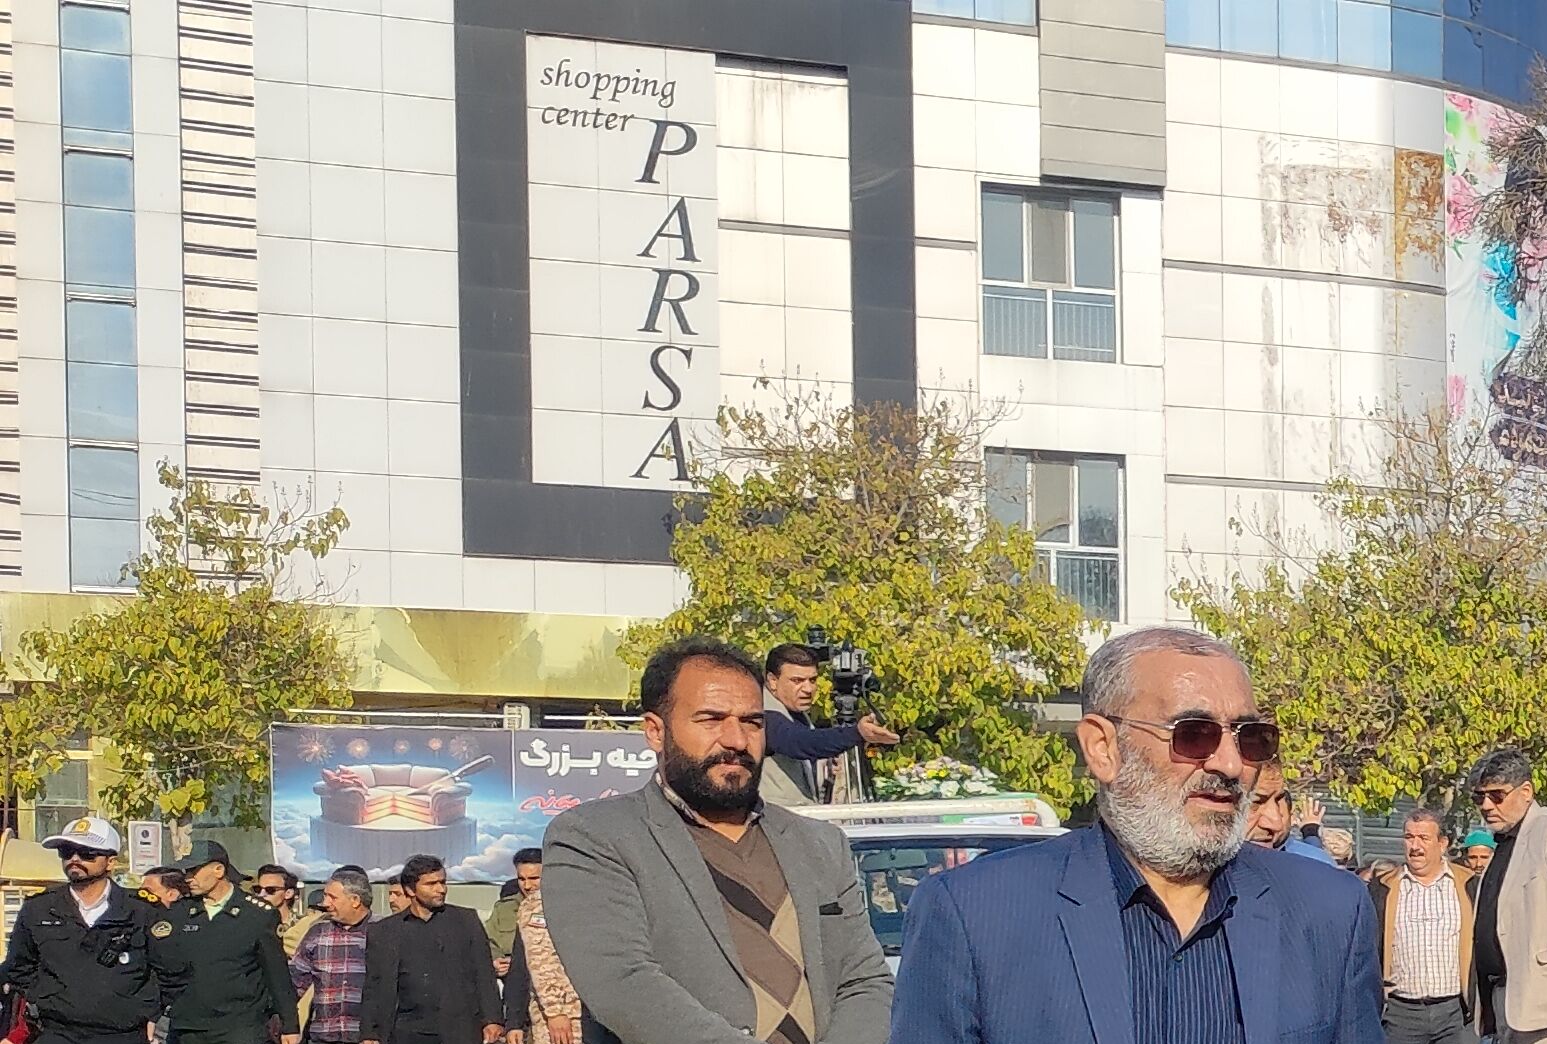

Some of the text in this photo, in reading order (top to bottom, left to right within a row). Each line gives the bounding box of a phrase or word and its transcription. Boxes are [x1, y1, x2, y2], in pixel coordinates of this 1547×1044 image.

[540, 59, 676, 108] shopping
[540, 105, 634, 132] center
[629, 119, 702, 482] PARSA
[519, 737, 602, 777] بزرگ
